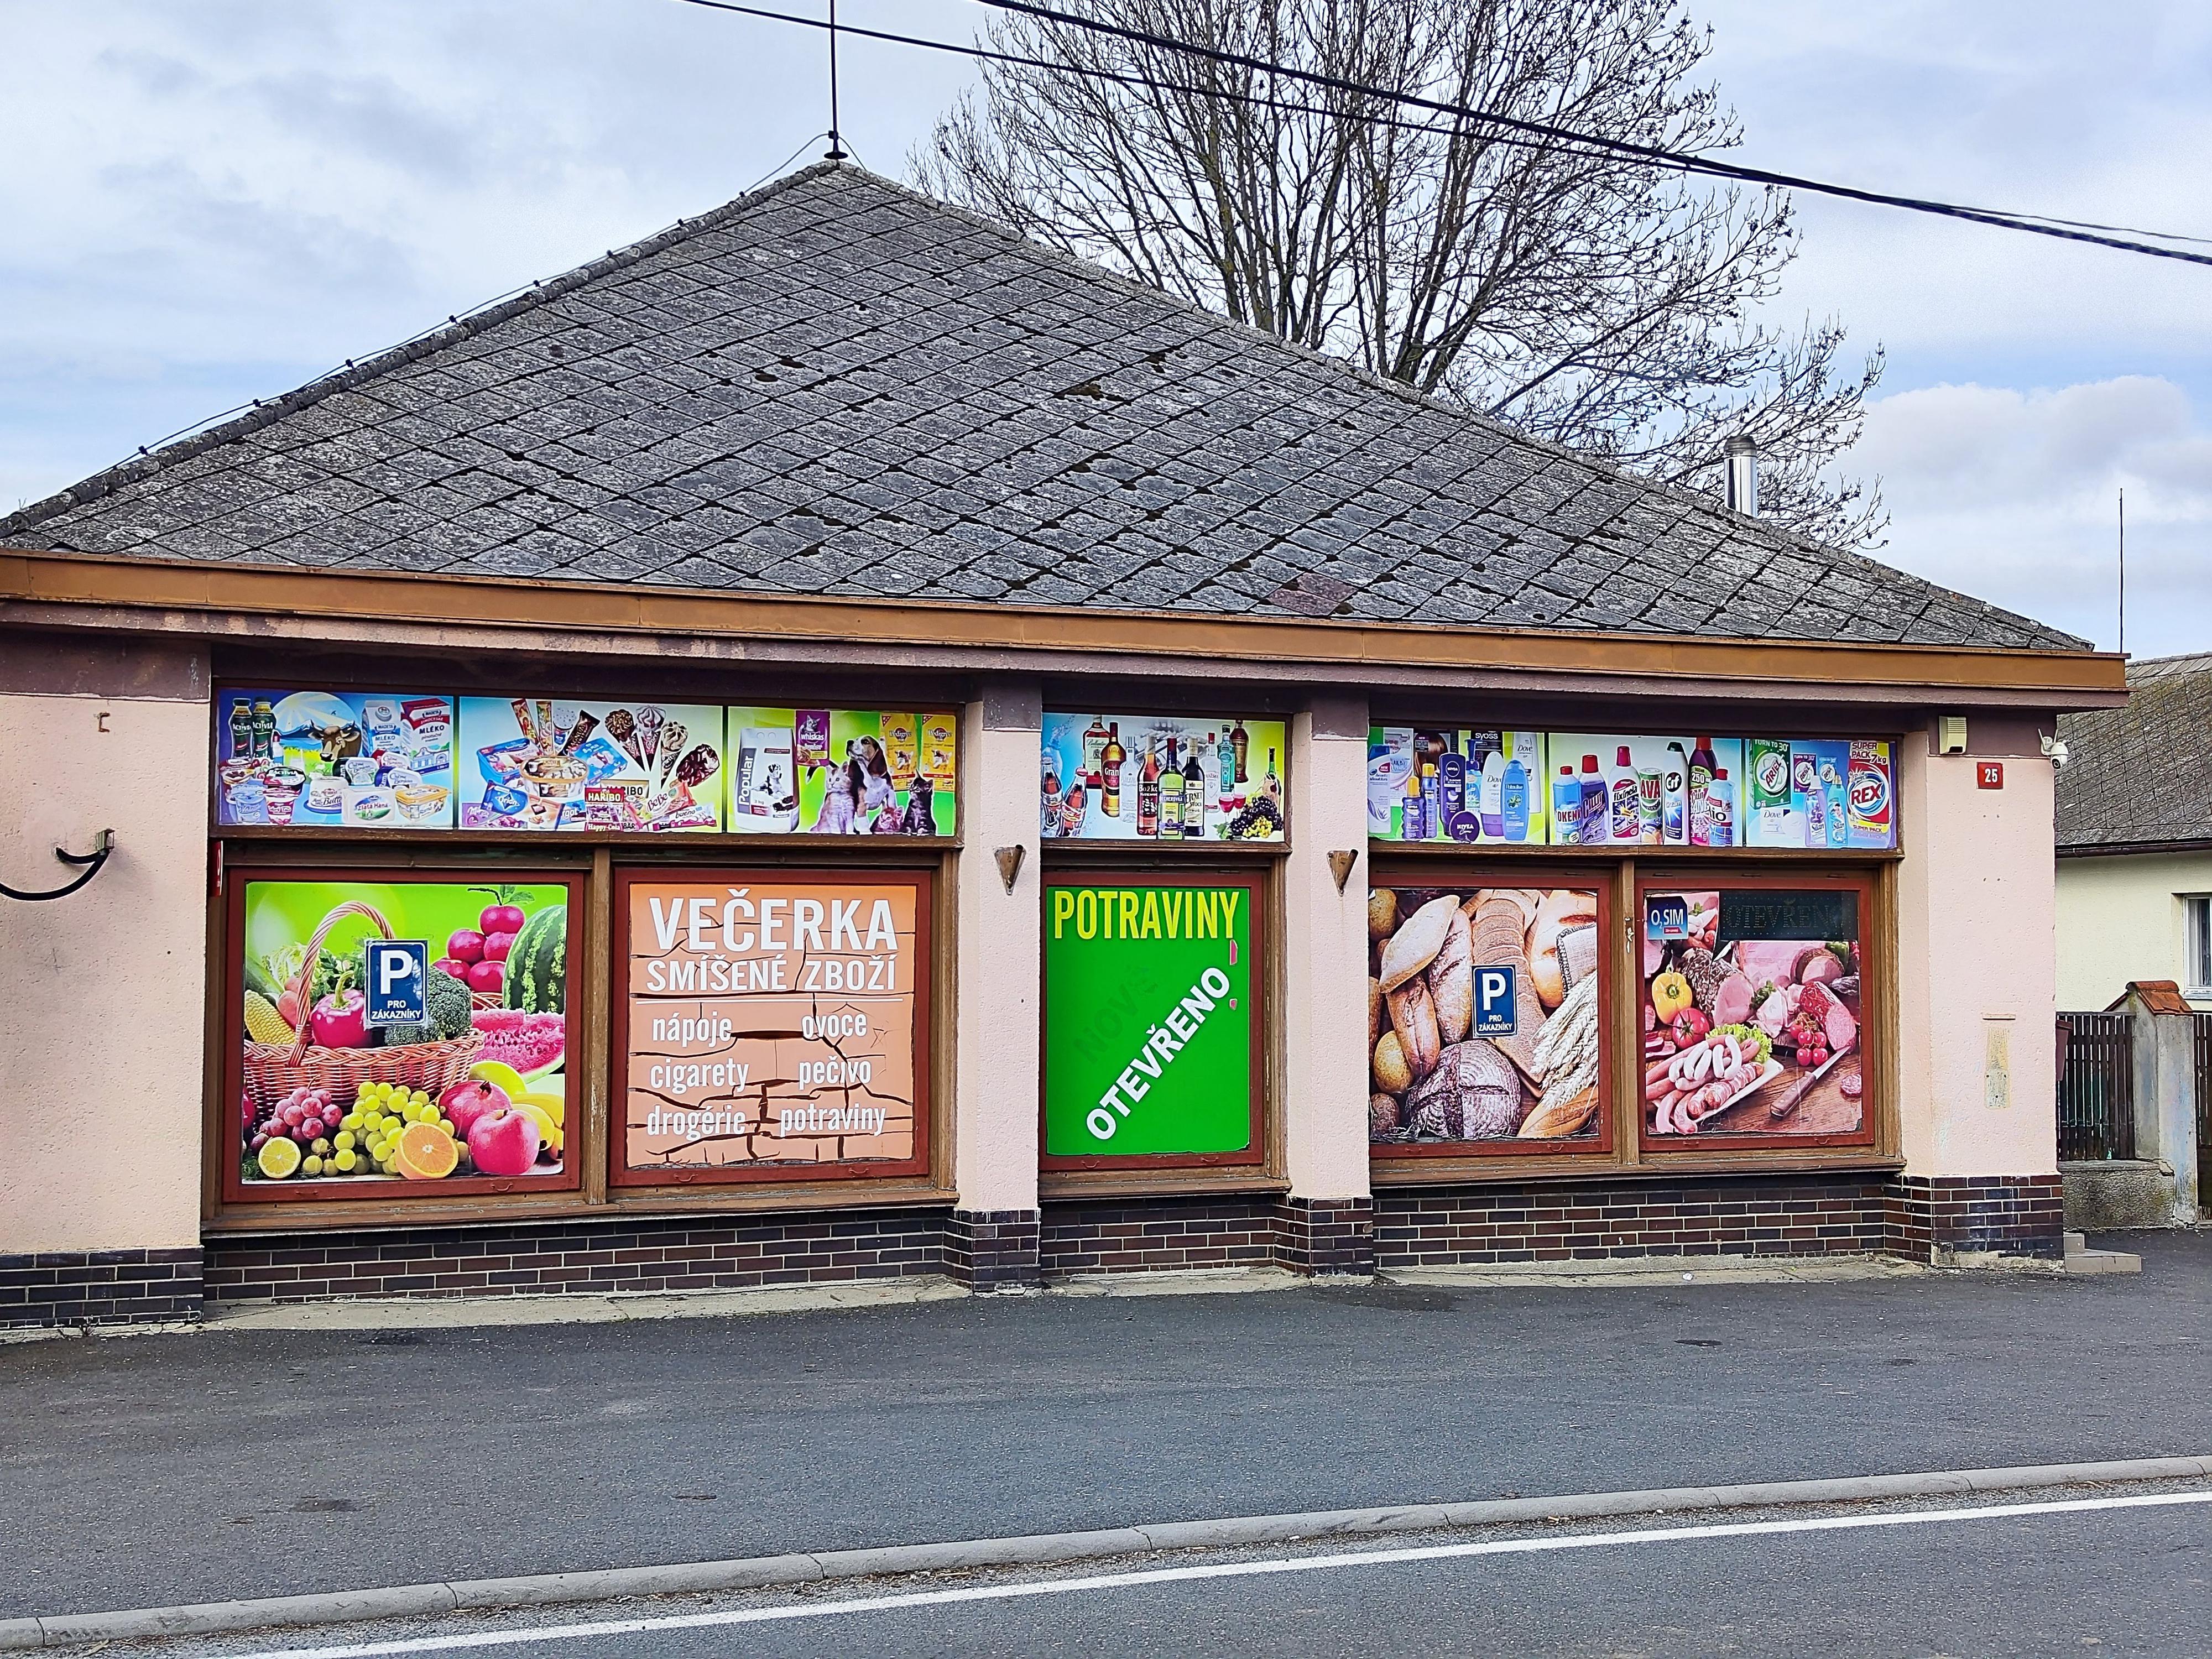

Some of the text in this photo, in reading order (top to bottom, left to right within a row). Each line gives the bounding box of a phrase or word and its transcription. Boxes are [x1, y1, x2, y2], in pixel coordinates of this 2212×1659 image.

[419, 725, 445, 734] MLÉKO
[565, 723, 587, 752] MAGNUM
[801, 733, 824, 741] whiskas
[1851, 742, 1877, 750] SUPER
[1851, 750, 1871, 759] PACK
[738, 755, 754, 806] Popular
[1691, 772, 1705, 785] 250
[1765, 759, 1782, 788] ARIEL
[1799, 765, 1811, 781] ARIEL
[1985, 768, 1998, 782] 25
[1640, 779, 1661, 799] AVA
[1665, 775, 1680, 790] Cif
[498, 797, 518, 806] Orion
[588, 792, 620, 802] HARIBO
[1851, 783, 1882, 805] REX
[675, 810, 696, 818] bueno
[1557, 807, 1581, 822] OKENA
[1764, 810, 1781, 818] Dove
[649, 888, 898, 951] VEČERKA
[1054, 890, 1239, 940] POTRAVINY
[1663, 909, 1683, 925] SIM
[380, 950, 413, 994] P
[646, 953, 897, 992] SMÍŠENÉ ZBOŽÍ
[1482, 973, 1506, 1011] P
[387, 1000, 406, 1009] PRO
[371, 1009, 421, 1019] ZÁKAZNÍKY
[652, 1011, 733, 1048] nápoje
[801, 1013, 867, 1038] ovoce
[1478, 1021, 1512, 1031] ZÁKAZNÍKY
[1086, 967, 1230, 1140] OTEVŘENO
[650, 1057, 749, 1094] cigarety
[799, 1055, 872, 1091] pečivo
[646, 1104, 747, 1141] drogérie
[780, 1103, 886, 1138] potraviny
